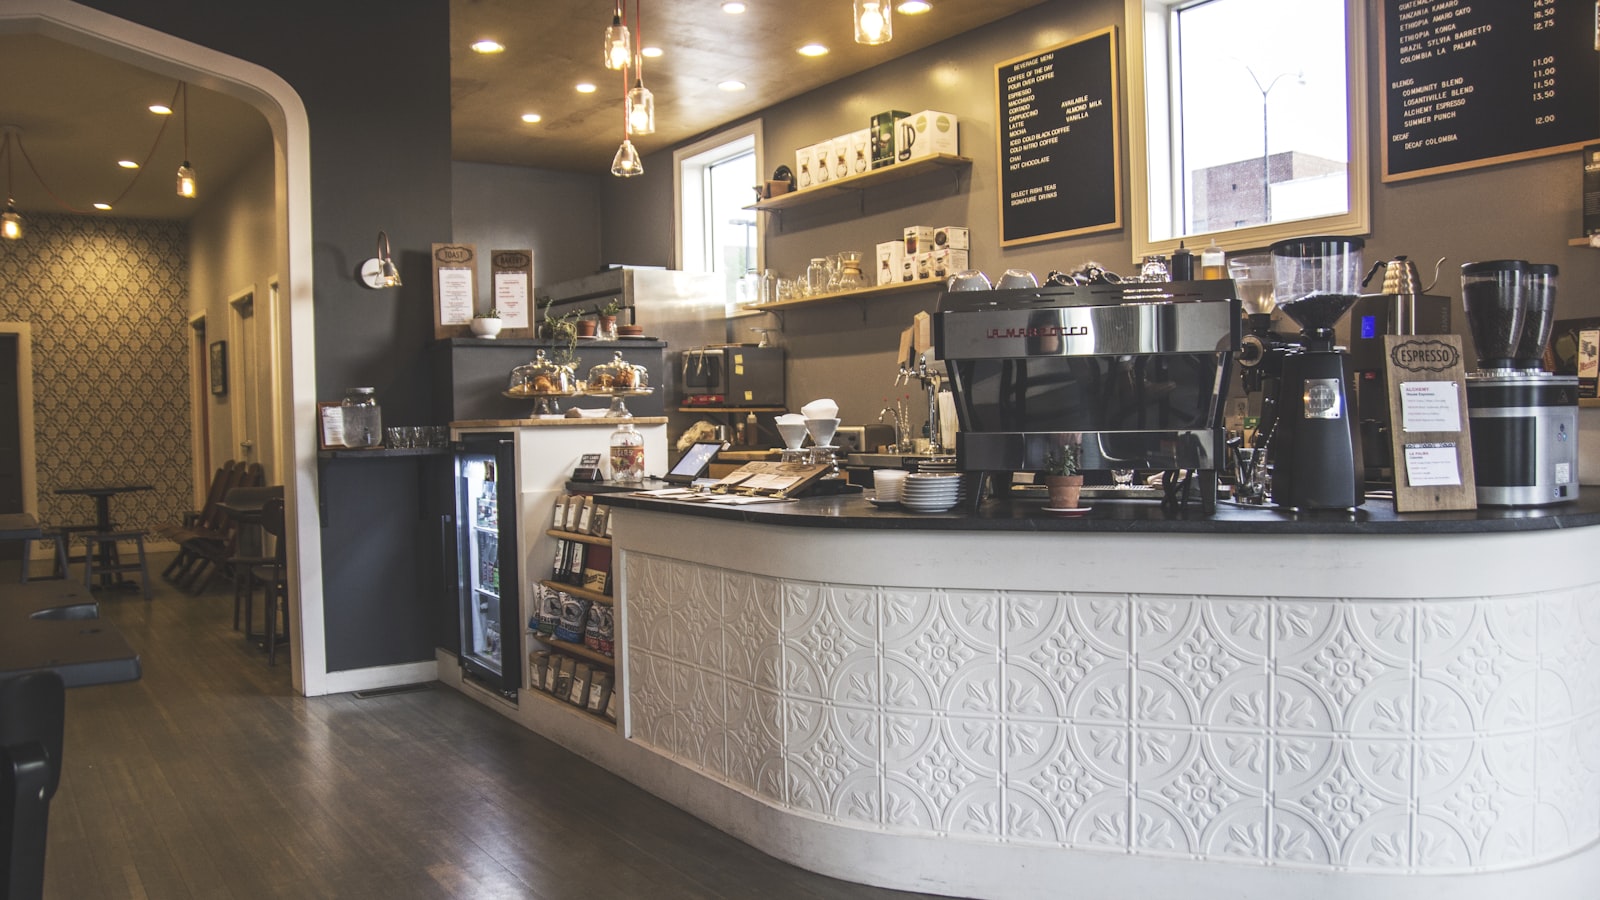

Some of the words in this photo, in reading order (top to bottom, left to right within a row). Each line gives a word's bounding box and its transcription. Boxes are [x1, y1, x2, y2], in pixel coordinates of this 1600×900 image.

[1399, 0, 1434, 11] GUATEMA
[1399, 8, 1429, 20] TANZANIA
[1534, 8, 1555, 19] 16.50
[1400, 19, 1429, 31] ETHIOPIA
[1432, 12, 1453, 22] AMARO
[1534, 19, 1554, 30] 12.75
[1400, 31, 1430, 44] ETHIOPIA
[1400, 44, 1423, 54] BRAZIL
[1427, 36, 1451, 47] SYLVIA
[1455, 24, 1492, 40] BARRETTO
[1400, 51, 1432, 64] COLOMBIA
[1453, 40, 1476, 51] PALMA
[1014, 58, 1038, 71] BEVERAGE
[1040, 53, 1054, 63] MENU
[1533, 56, 1554, 67] 11.00
[1007, 73, 1025, 83] COFFEE
[1026, 70, 1033, 78] OF
[1044, 64, 1054, 73] DAY
[1534, 67, 1556, 78] 11.00
[1008, 81, 1021, 91] POUR
[1022, 78, 1035, 87] OVER
[1036, 72, 1054, 82] COFFEE
[1402, 83, 1438, 97] COMMUNITY
[1441, 77, 1464, 88] BLEND
[1534, 79, 1555, 89] 11.50
[1008, 88, 1032, 100] ESPRESSO
[1008, 94, 1035, 107] MACCHIATO
[1404, 91, 1447, 107] LOSANTIVILLE
[1451, 85, 1474, 96] BLEND
[1533, 90, 1555, 101] 13.50
[1061, 95, 1088, 108] AVAILABLE
[1066, 103, 1087, 115] ALMOND
[1089, 99, 1102, 109] MILK
[1404, 105, 1432, 117] ALCHEMY
[1436, 98, 1466, 111] ESPRESSO
[1009, 109, 1039, 123] CAPPUCCINO
[1066, 112, 1089, 122] VANILLA
[1404, 116, 1432, 127] SUMMER
[1434, 111, 1456, 121] PUNCH
[1535, 114, 1555, 125] 12.00
[1009, 121, 1024, 130] LATTE
[1009, 128, 1027, 137] MOCHA
[1010, 138, 1021, 146] ICED
[1022, 134, 1035, 143] COLD
[1036, 130, 1051, 139] BLACK
[1051, 126, 1070, 136] COFFEE
[1392, 132, 1410, 142] DECAF
[1010, 145, 1022, 154] COLD
[1023, 141, 1038, 151] NITRO
[1039, 136, 1058, 147] COFFEE
[1405, 140, 1423, 150] DECAF
[1425, 134, 1458, 146] COLOMBIA
[1010, 155, 1021, 163] CHAI
[1010, 163, 1020, 171] HOT
[1021, 156, 1050, 168] CHOCOLATE
[1011, 189, 1028, 199] SELECT
[1044, 183, 1057, 191] TEAS
[1011, 196, 1037, 206] SIGNATURE
[1038, 192, 1057, 201] DRINKS
[444, 251, 463, 259] TOAST
[1401, 349, 1449, 362] ESPRESSO
